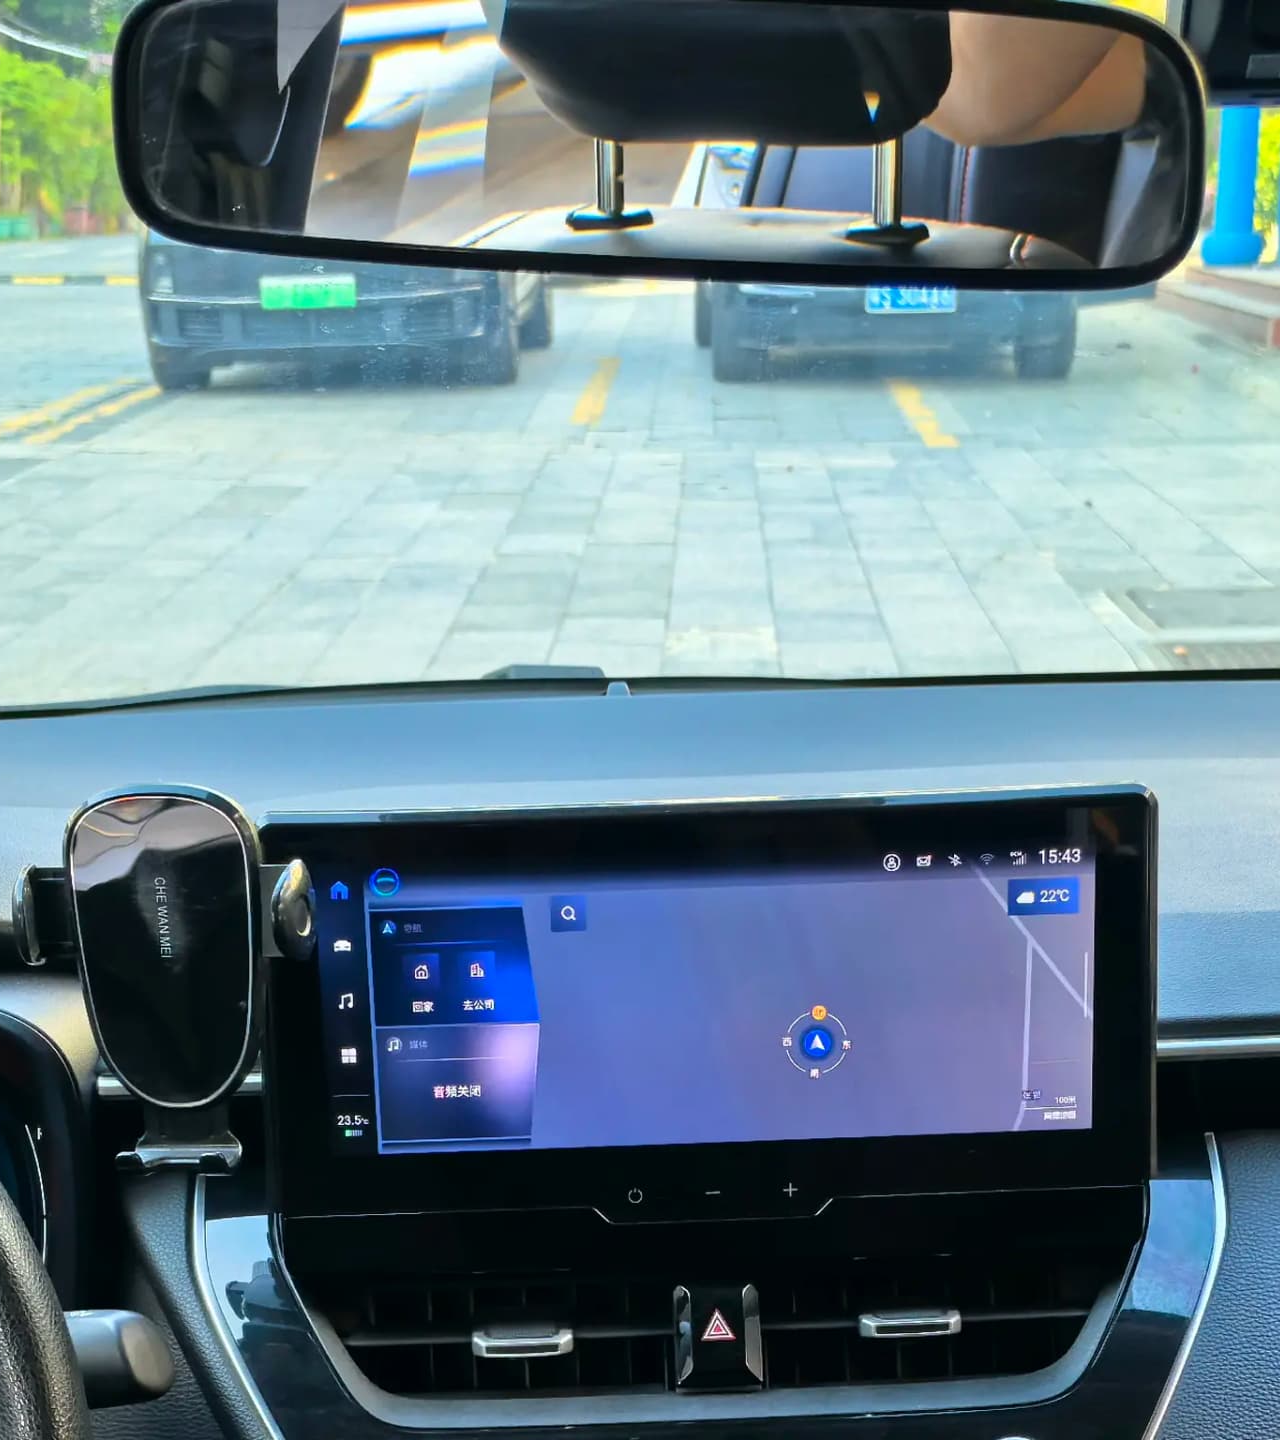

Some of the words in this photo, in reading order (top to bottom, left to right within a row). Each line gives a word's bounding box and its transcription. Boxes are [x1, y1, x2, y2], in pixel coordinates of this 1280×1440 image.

[1038, 848, 1081, 864] 15:43
[154, 877, 168, 903] CHE
[157, 905, 170, 934] WAN
[160, 936, 173, 958] MEI
[412, 1001, 434, 1013] 回家
[463, 999, 495, 1011] 去公司
[782, 1037, 792, 1047] 西
[842, 1040, 851, 1050] 东
[433, 1085, 481, 1098] 音频关闭
